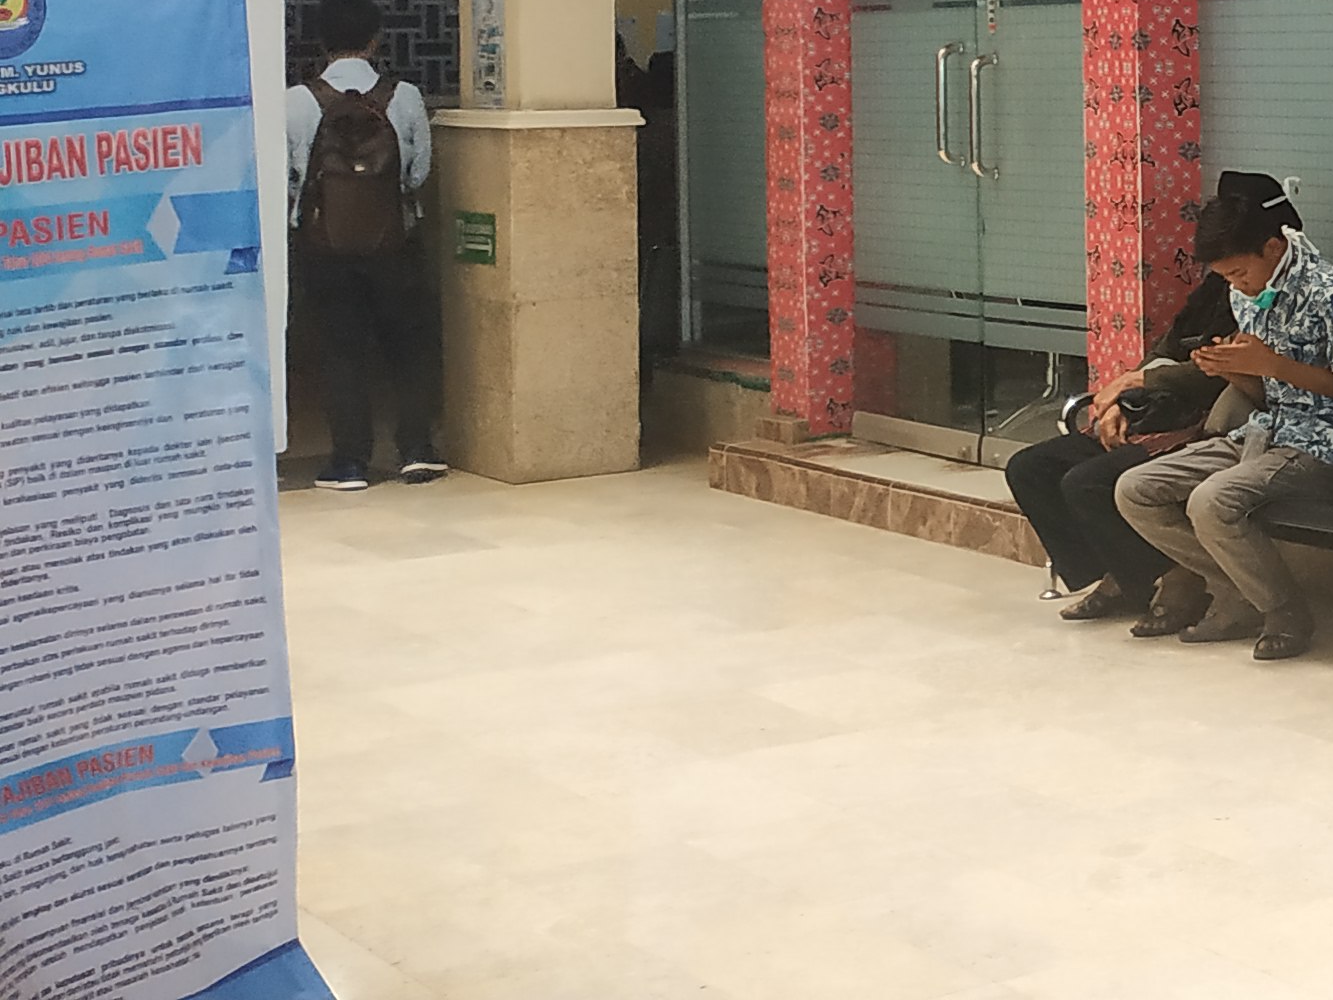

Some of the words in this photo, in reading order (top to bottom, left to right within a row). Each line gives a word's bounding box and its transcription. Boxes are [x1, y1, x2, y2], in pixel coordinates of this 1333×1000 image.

[24, 61, 85, 77] YUNUS
[0, 135, 88, 186] JIBAN
[96, 124, 203, 176] PASIEN
[76, 743, 155, 780] PASIEN
